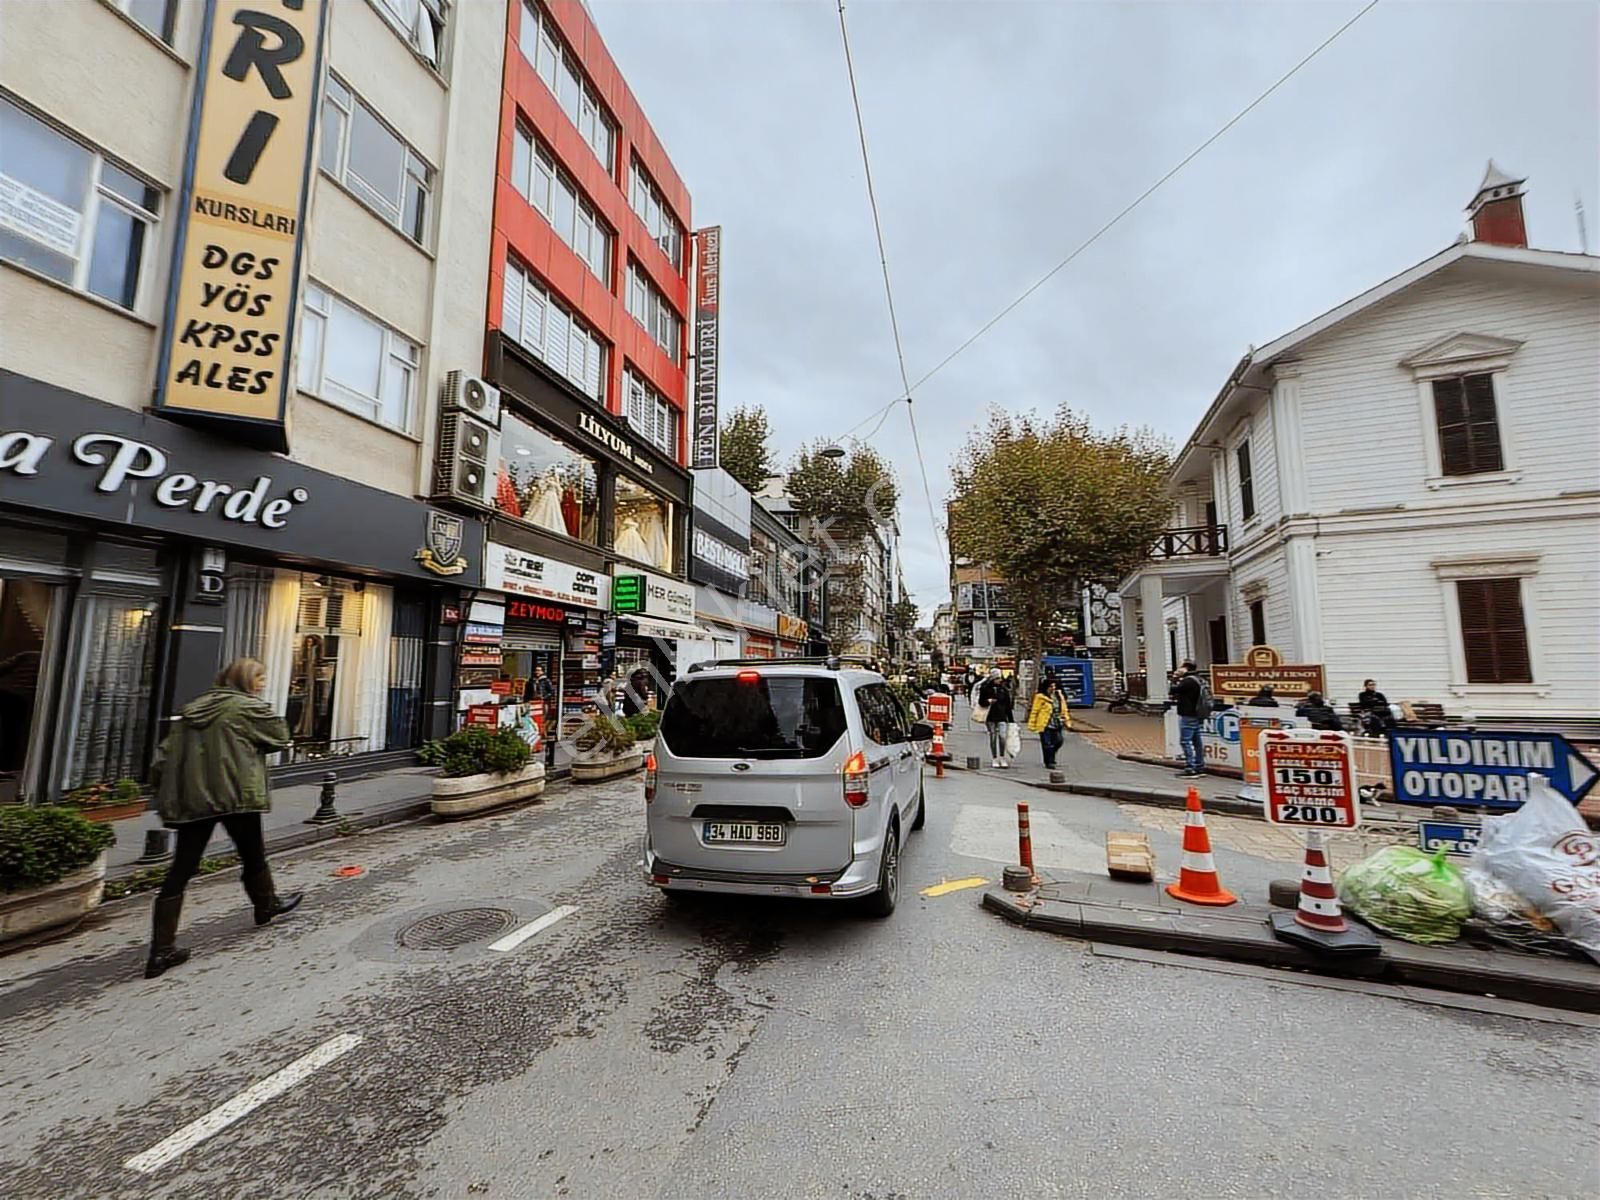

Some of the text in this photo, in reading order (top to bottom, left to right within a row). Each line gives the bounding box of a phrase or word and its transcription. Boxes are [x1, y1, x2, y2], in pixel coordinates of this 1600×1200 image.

[195, 196, 296, 235] KURSLARI
[201, 244, 280, 280] DGS
[200, 283, 271, 317] YÖS
[180, 319, 280, 357] KPSS
[175, 359, 274, 395] ALES
[508, 601, 565, 622] ZEYMOD
[1203, 742, 1229, 762] RİŞ
[1395, 737, 1554, 768] YILDIRIM
[1403, 770, 1530, 802] OTOPAR
[711, 824, 726, 839] 34
[757, 825, 780, 841] 968
